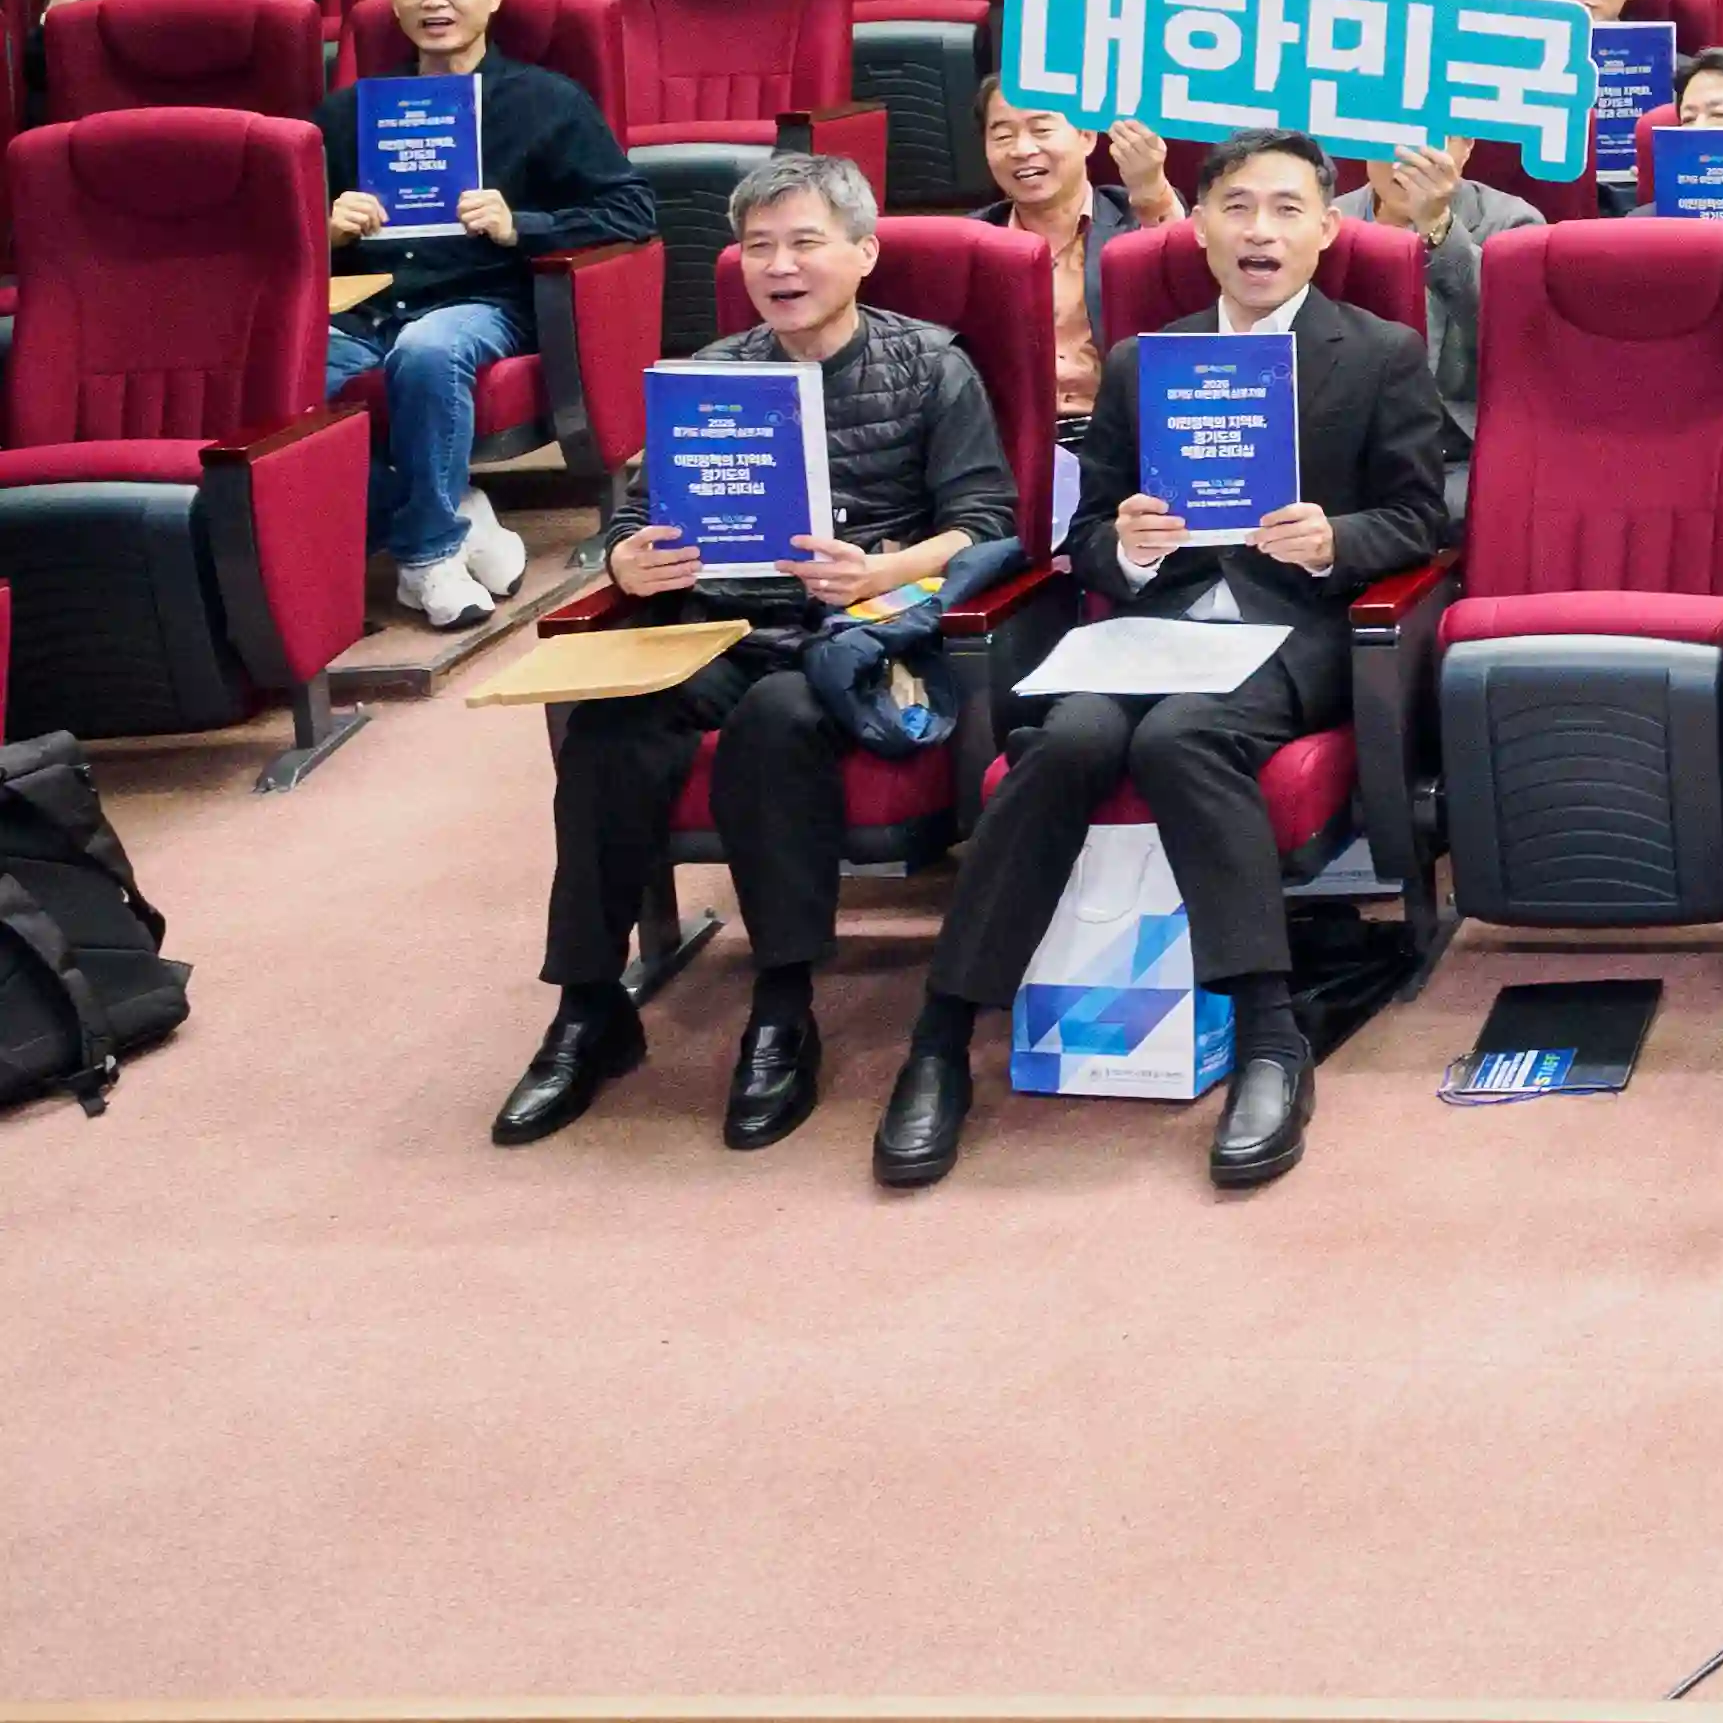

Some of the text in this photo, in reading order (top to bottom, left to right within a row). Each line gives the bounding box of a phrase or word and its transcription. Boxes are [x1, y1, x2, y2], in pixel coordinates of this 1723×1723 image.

[1167, 416, 1227, 430] 이민정책의
[1193, 430, 1241, 444] 경기도의
[674, 454, 734, 467] 이민정책의
[701, 468, 750, 481] 경기도의
[1534, 1054, 1561, 1086] STAFF
